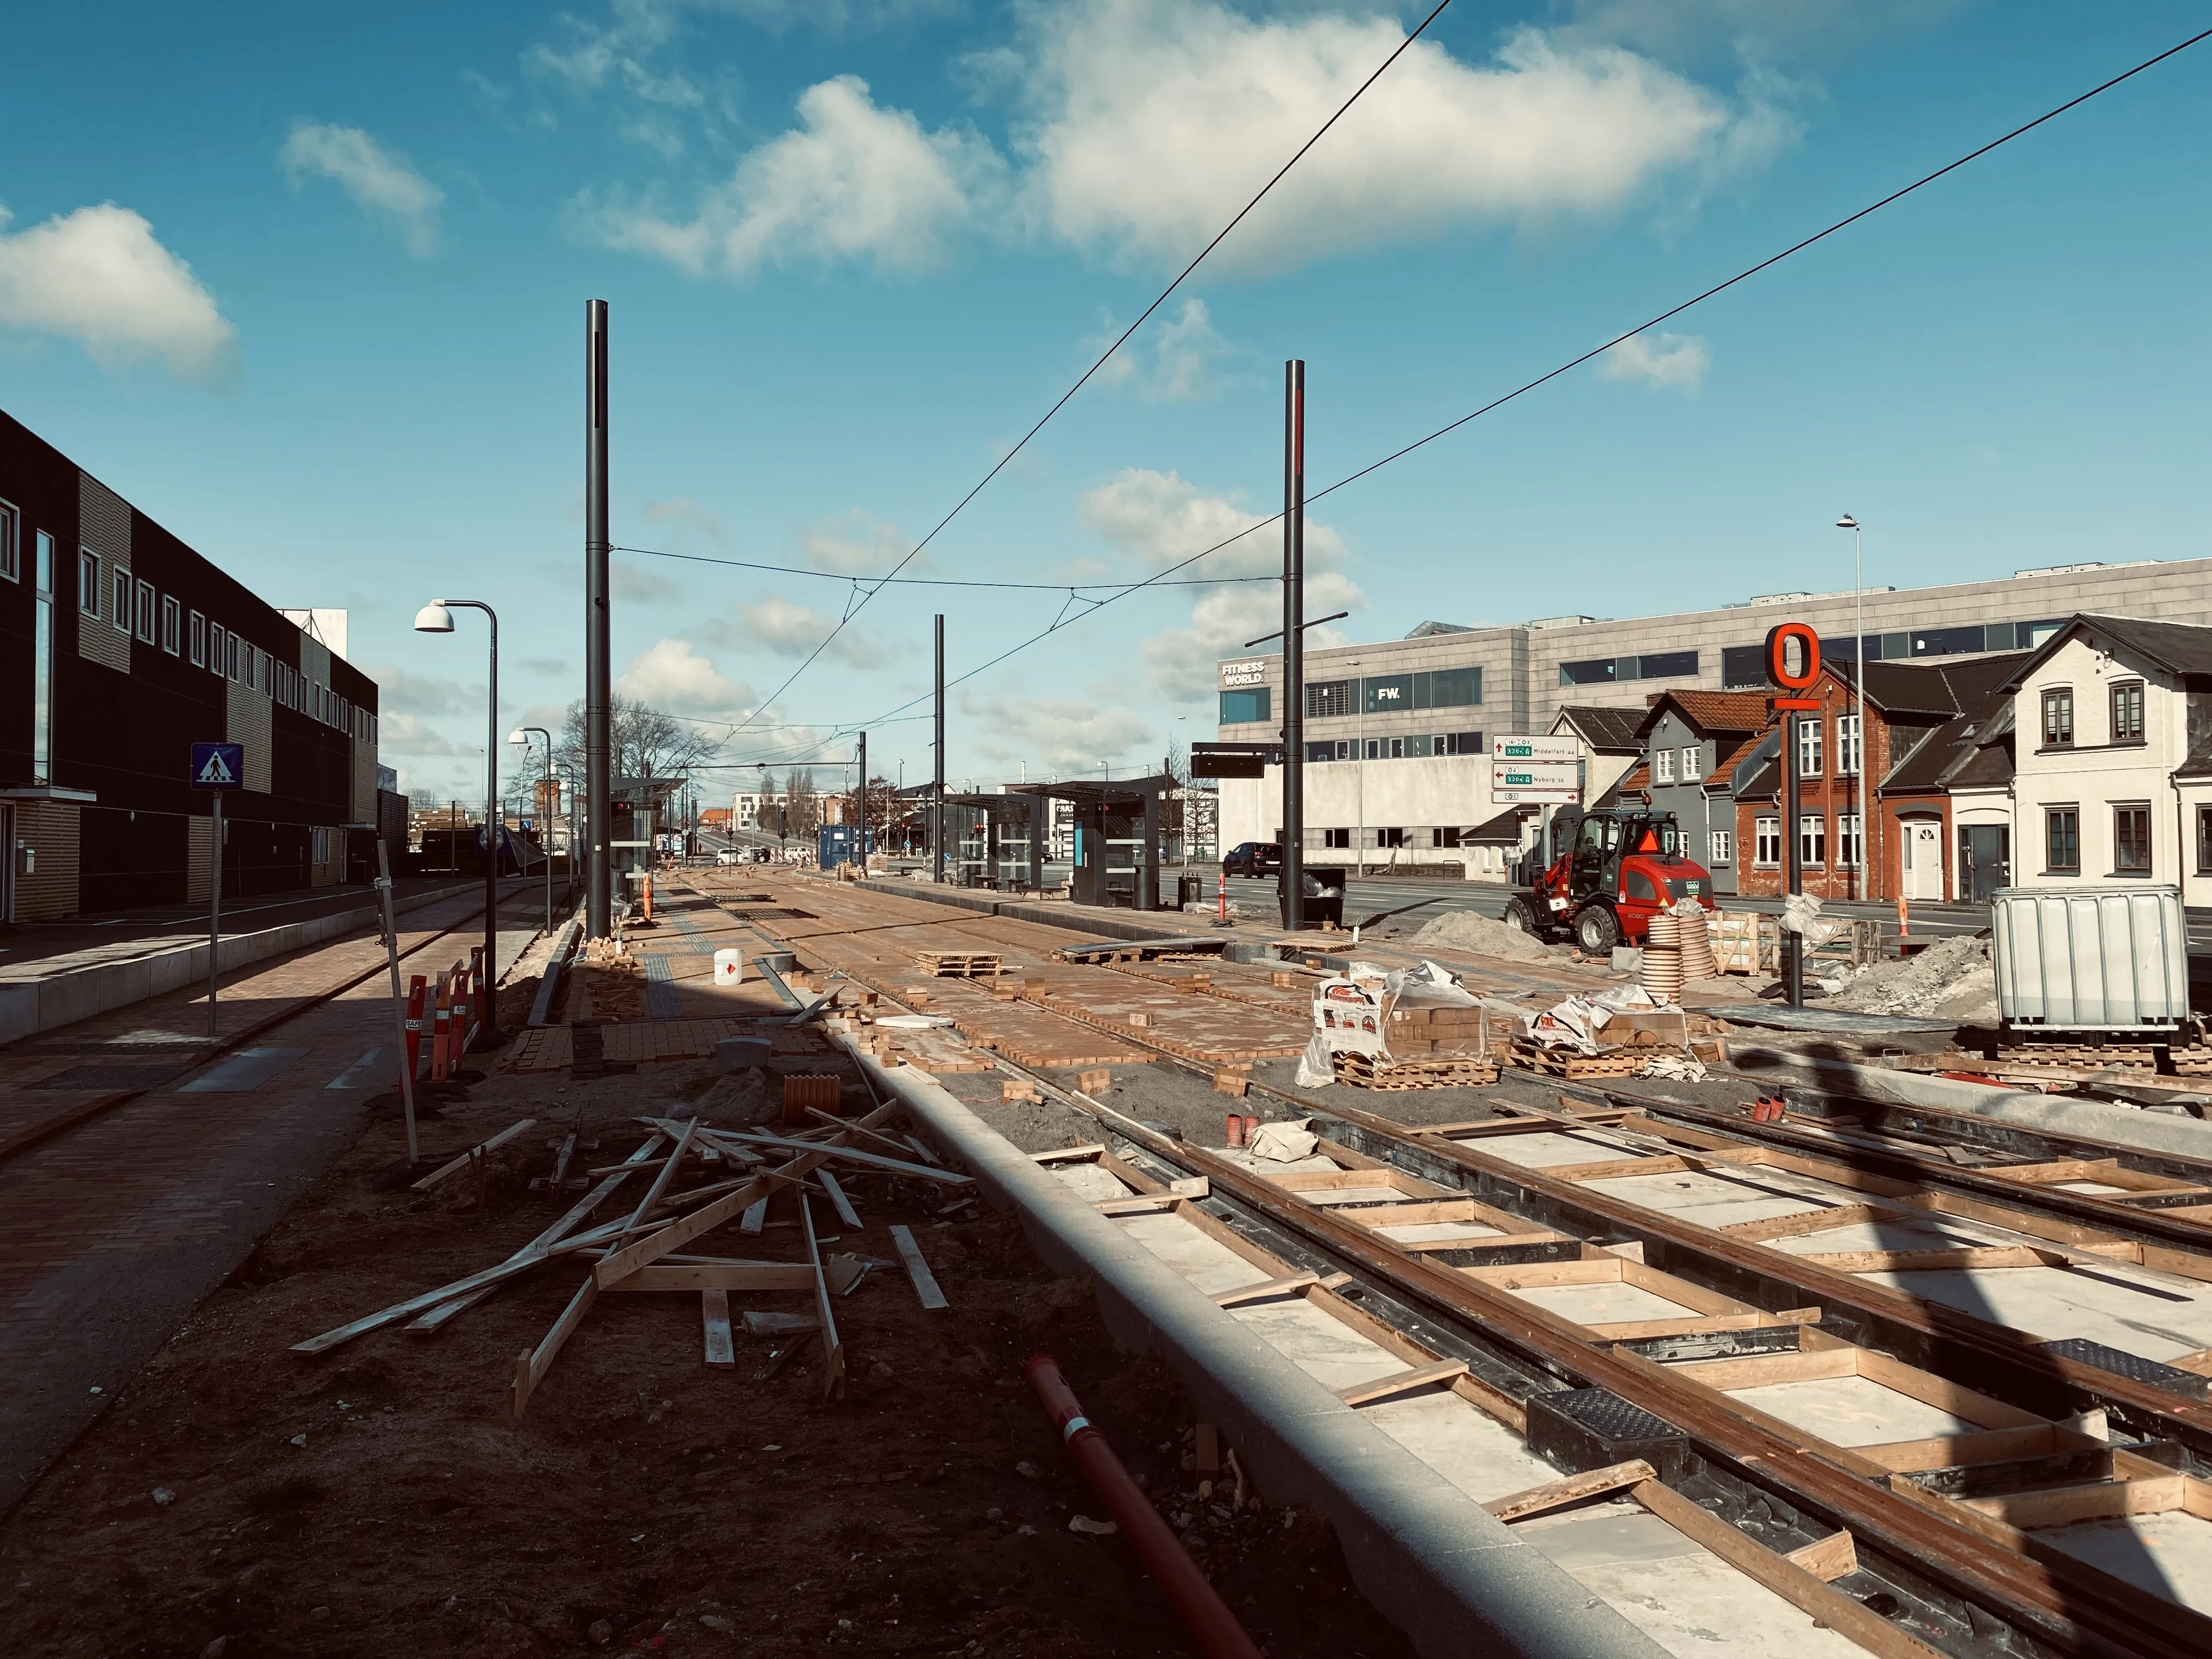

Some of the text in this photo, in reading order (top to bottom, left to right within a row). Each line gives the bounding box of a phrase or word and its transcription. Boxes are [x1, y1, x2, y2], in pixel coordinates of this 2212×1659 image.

[1222, 662, 1265, 676] FITNESS
[1224, 673, 1264, 686] WORLD.
[1378, 687, 1400, 700] FW.
